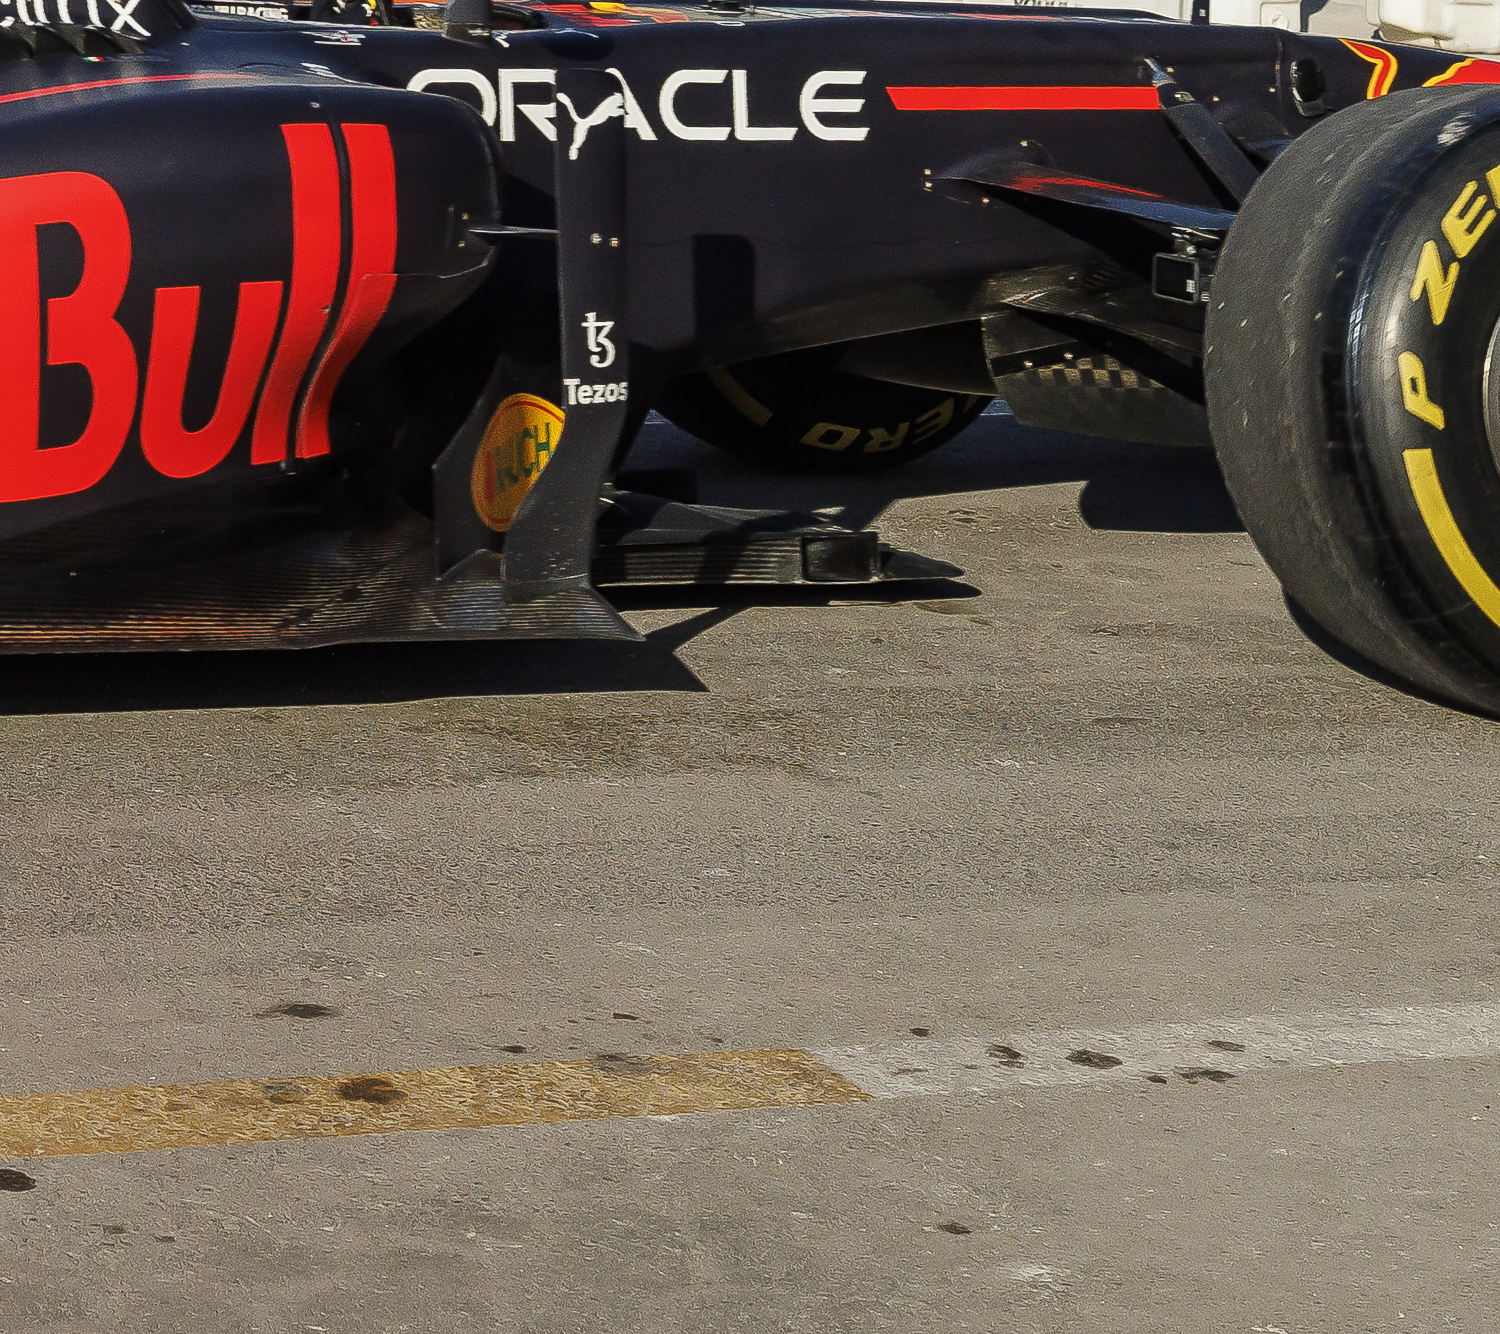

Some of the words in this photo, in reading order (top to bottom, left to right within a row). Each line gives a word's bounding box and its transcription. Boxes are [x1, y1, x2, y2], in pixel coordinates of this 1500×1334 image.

[562, 378, 628, 406] Tezos
[1401, 350, 1446, 430] P
[798, 396, 981, 455] ERO
